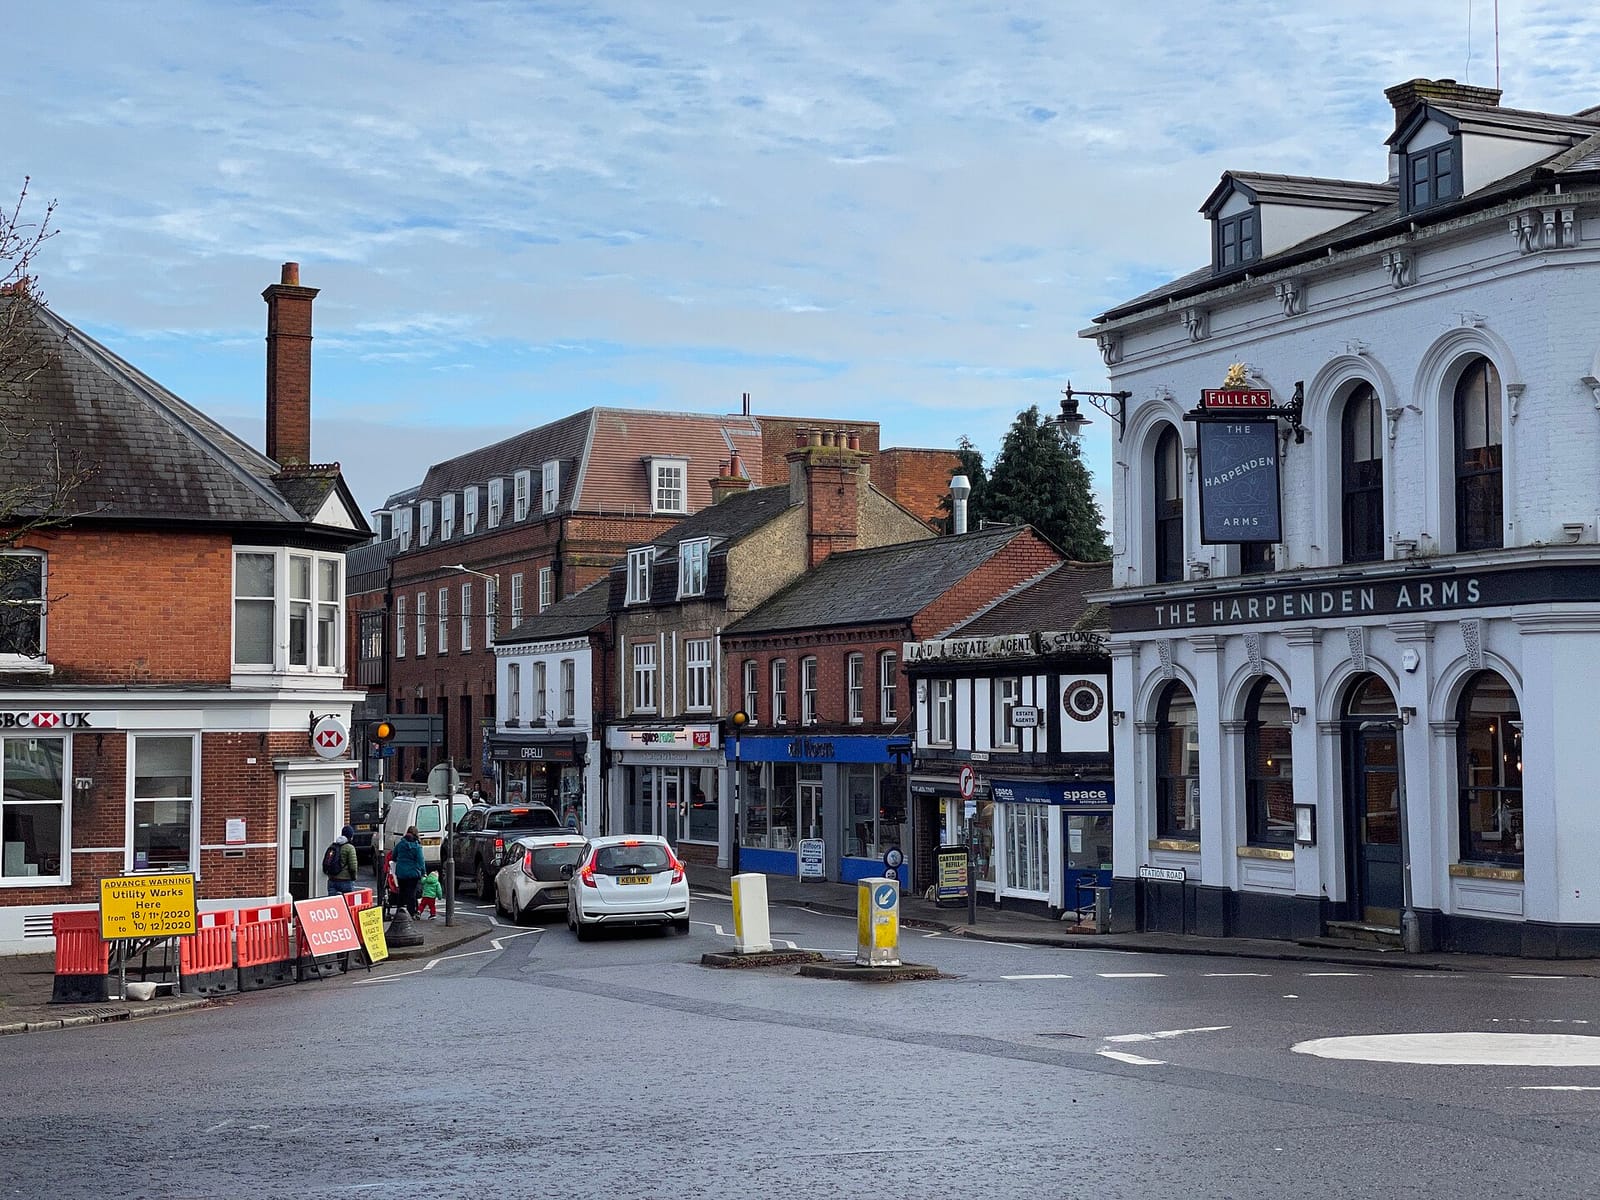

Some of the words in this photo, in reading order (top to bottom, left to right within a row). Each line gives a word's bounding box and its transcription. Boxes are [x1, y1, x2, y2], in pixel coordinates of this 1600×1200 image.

[1209, 392, 1267, 405] FULLER'S
[1226, 425, 1251, 434] THE
[1204, 456, 1275, 487] HARPENDEN
[1223, 517, 1258, 526] ARMS
[1155, 603, 1196, 625] THE
[1212, 588, 1375, 621] HARPENDEN
[1396, 579, 1480, 608] ARMS
[952, 640, 988, 655] ESTATE
[0, 712, 30, 728] BC
[61, 712, 93, 728] UK
[1063, 790, 1107, 801] space
[1141, 868, 1165, 878] STATION
[1166, 871, 1183, 880] ROAD
[104, 880, 146, 889] ADVANCE
[149, 878, 191, 886] WARNING
[112, 890, 146, 899] Utility
[150, 888, 184, 897] Works
[136, 901, 161, 909] Here
[309, 907, 338, 923] ROAD
[311, 928, 352, 946] CLOSED
